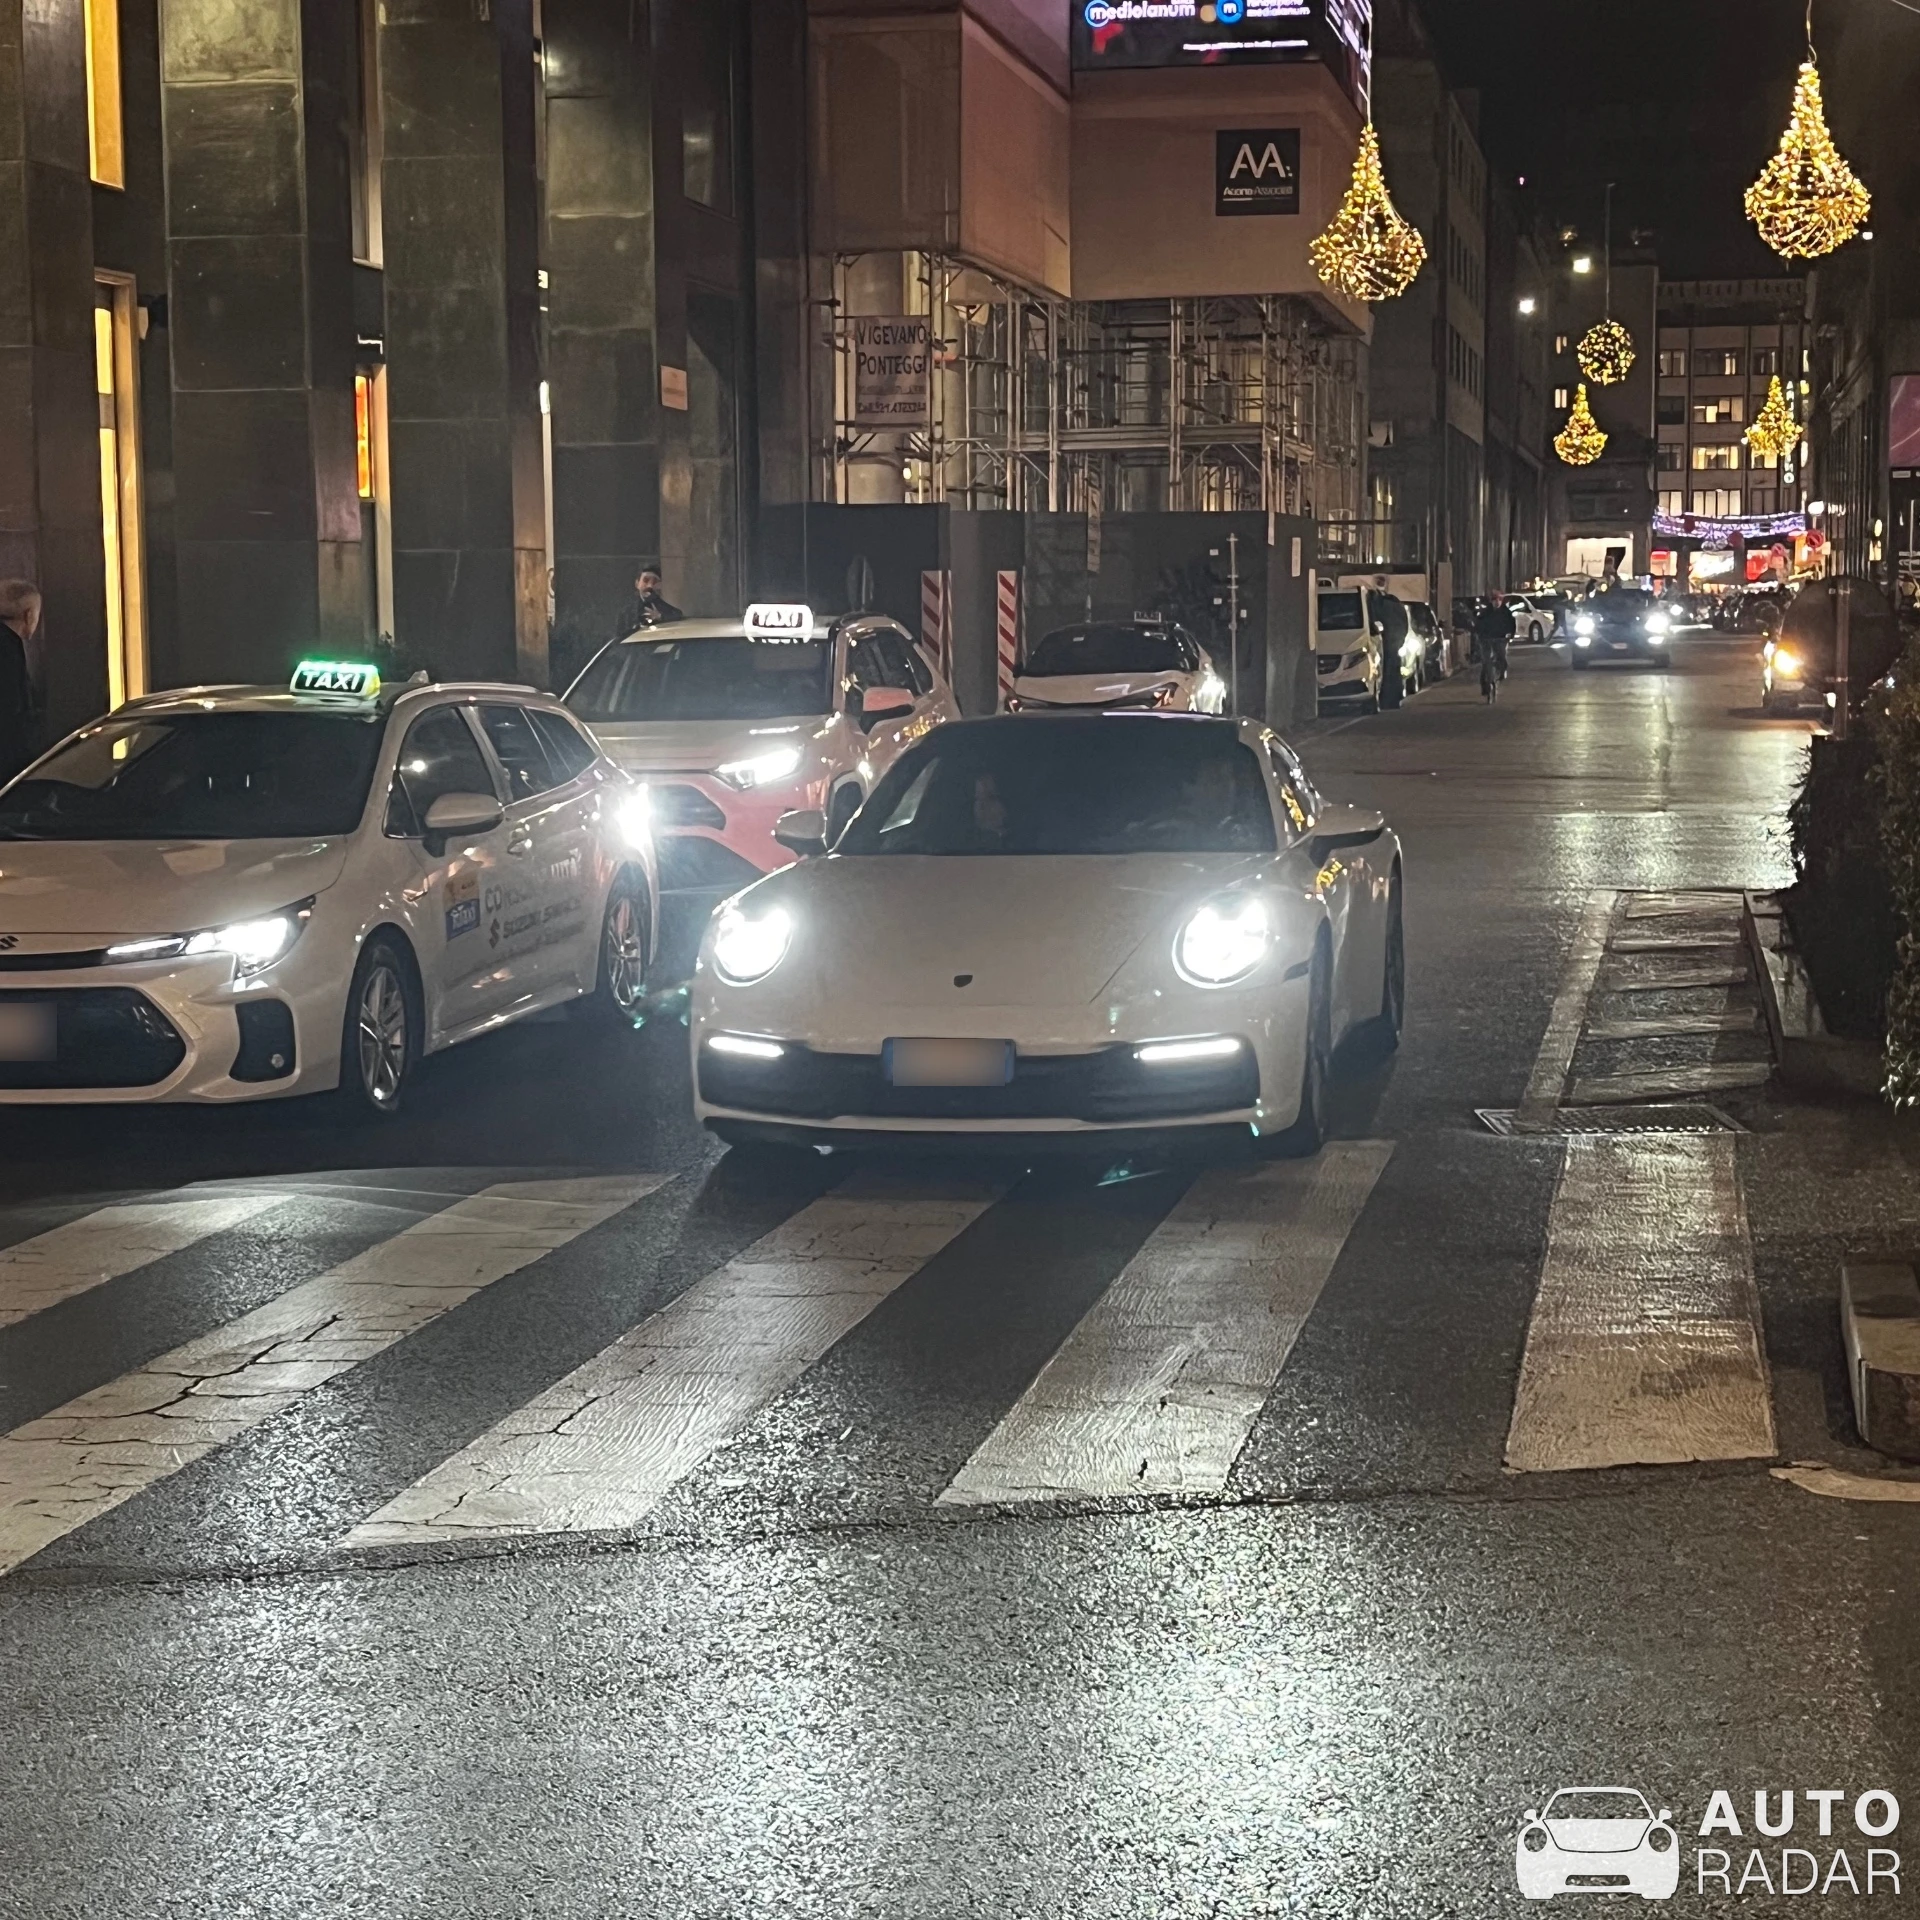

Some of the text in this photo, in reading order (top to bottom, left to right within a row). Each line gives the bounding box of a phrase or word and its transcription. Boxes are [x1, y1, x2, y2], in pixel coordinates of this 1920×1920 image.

[1090, 1, 1195, 20] mediolanum
[857, 322, 927, 345] VIGEVANO
[857, 352, 927, 375] PONTEGGI
[757, 610, 800, 628] TAXI
[303, 669, 361, 691] TAXI
